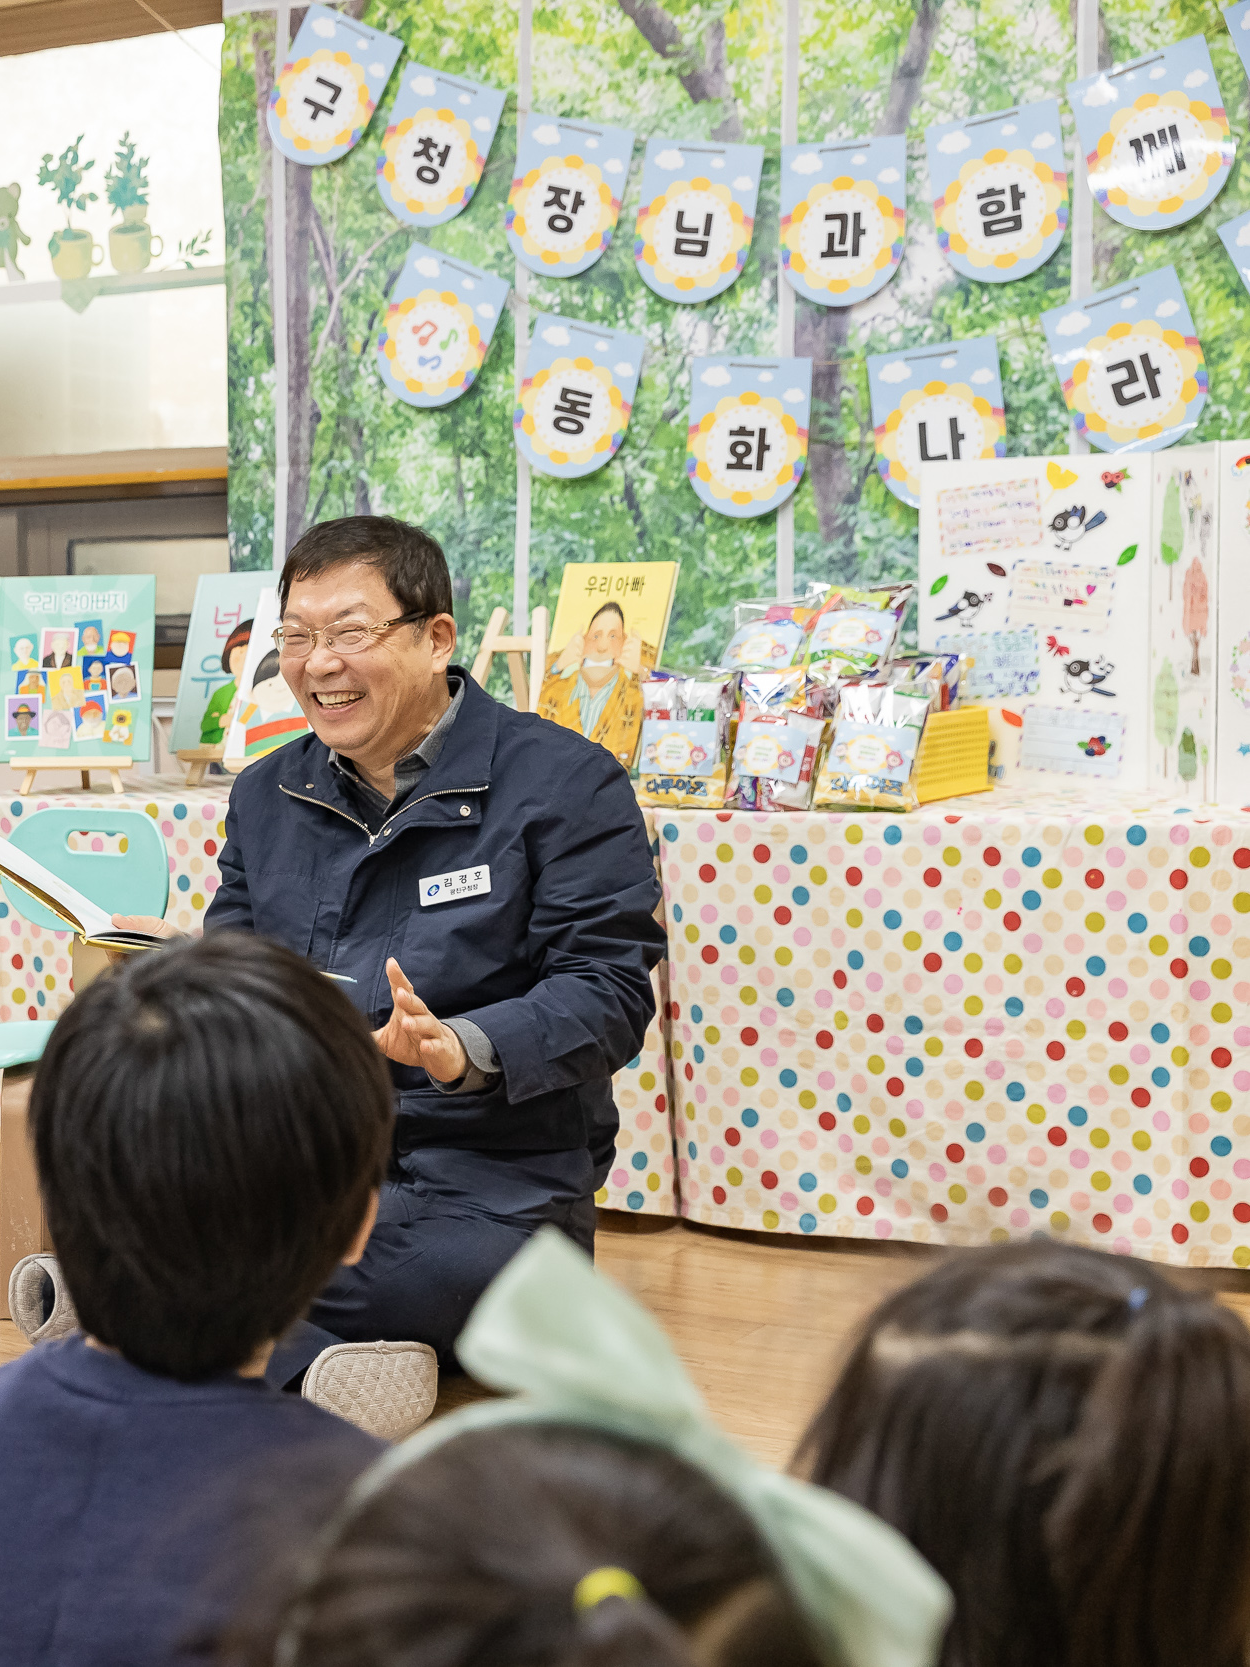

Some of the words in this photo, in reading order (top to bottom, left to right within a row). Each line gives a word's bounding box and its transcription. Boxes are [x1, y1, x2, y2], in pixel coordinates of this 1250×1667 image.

[303, 76, 342, 121] 구
[413, 137, 451, 185] 청
[543, 185, 586, 234] 장
[674, 210, 713, 258] 님
[820, 211, 866, 259] 과
[976, 183, 1026, 237] 함
[1129, 124, 1187, 179] 께
[553, 387, 593, 435] 동
[726, 425, 771, 472] 화
[918, 417, 965, 462] 나
[1106, 352, 1161, 407] 라
[24, 591, 58, 614] 우리
[62, 590, 127, 614] 할아버지
[584, 575, 613, 597] 우리
[615, 575, 646, 597] 아빠
